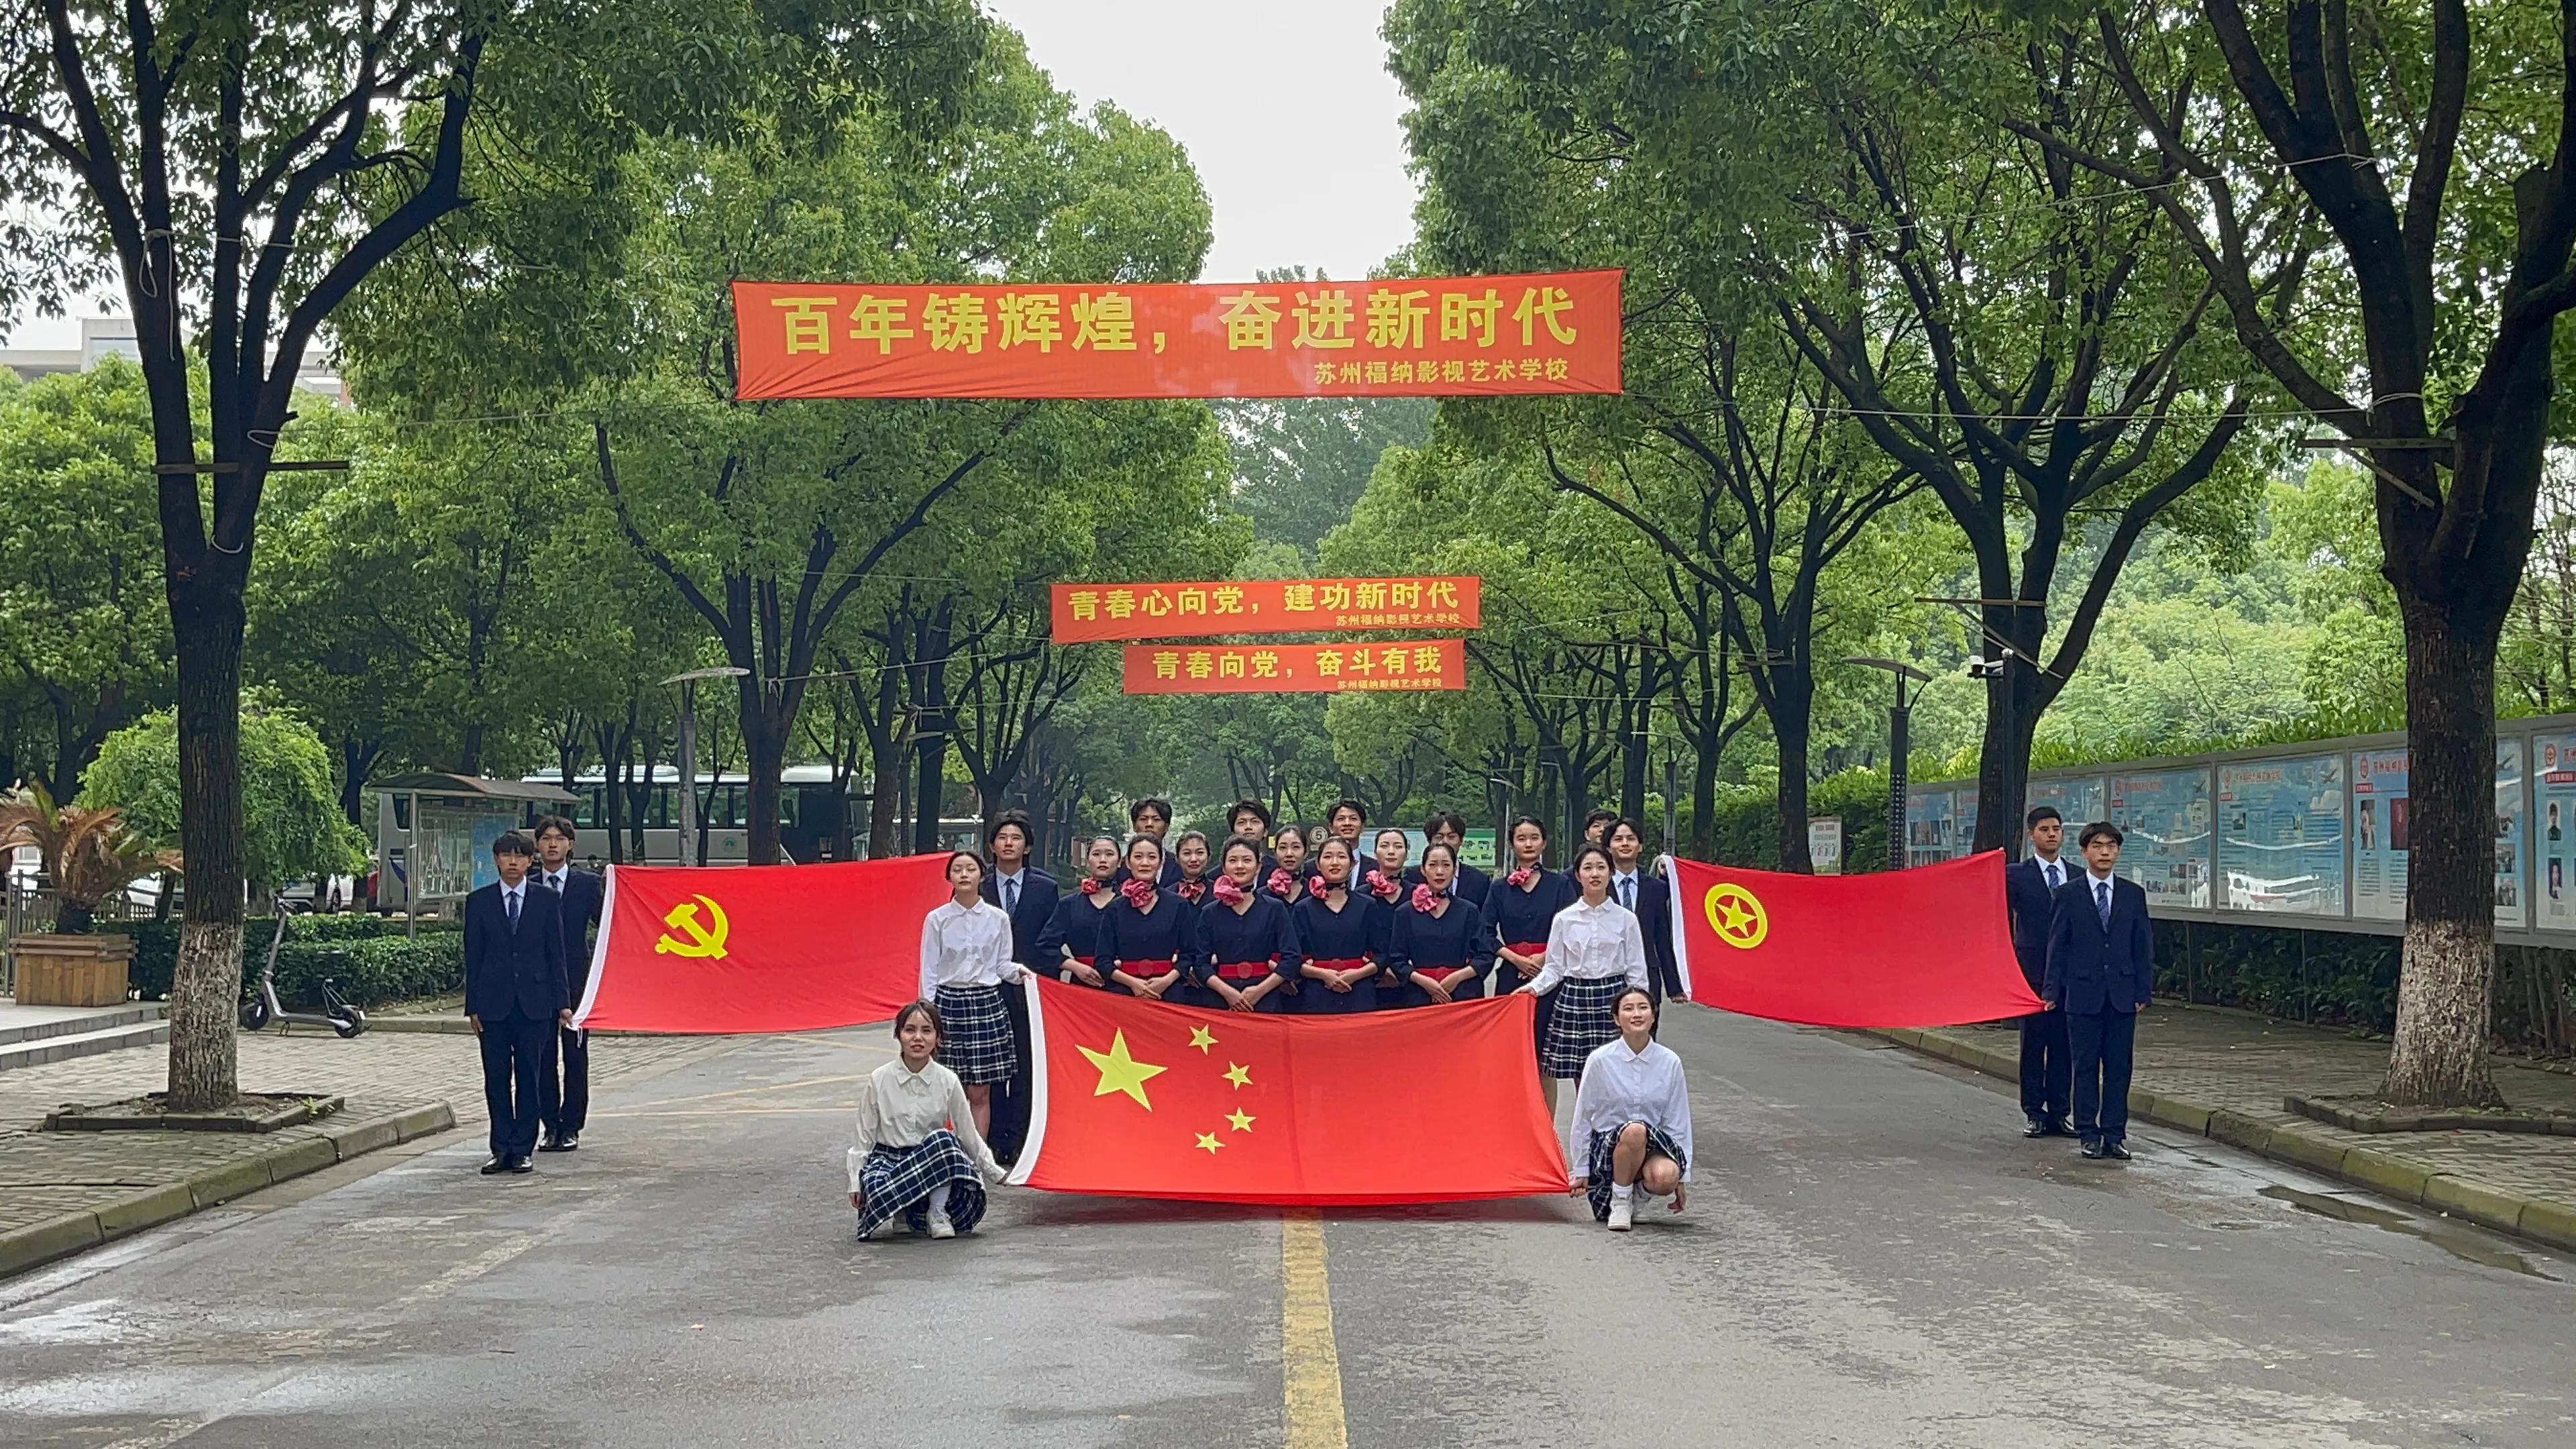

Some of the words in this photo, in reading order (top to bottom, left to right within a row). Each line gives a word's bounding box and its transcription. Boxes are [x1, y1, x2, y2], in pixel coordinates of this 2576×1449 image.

[771, 286, 1578, 355] 百年铸辉煌，奋进新时代
[1313, 358, 1568, 385] 苏州福纳影视艺术学校
[1068, 581, 1459, 621] 青春心向党，建功新时代
[1152, 645, 1442, 680] 青春向党，奋斗有我
[1316, 830, 1322, 840] 5
